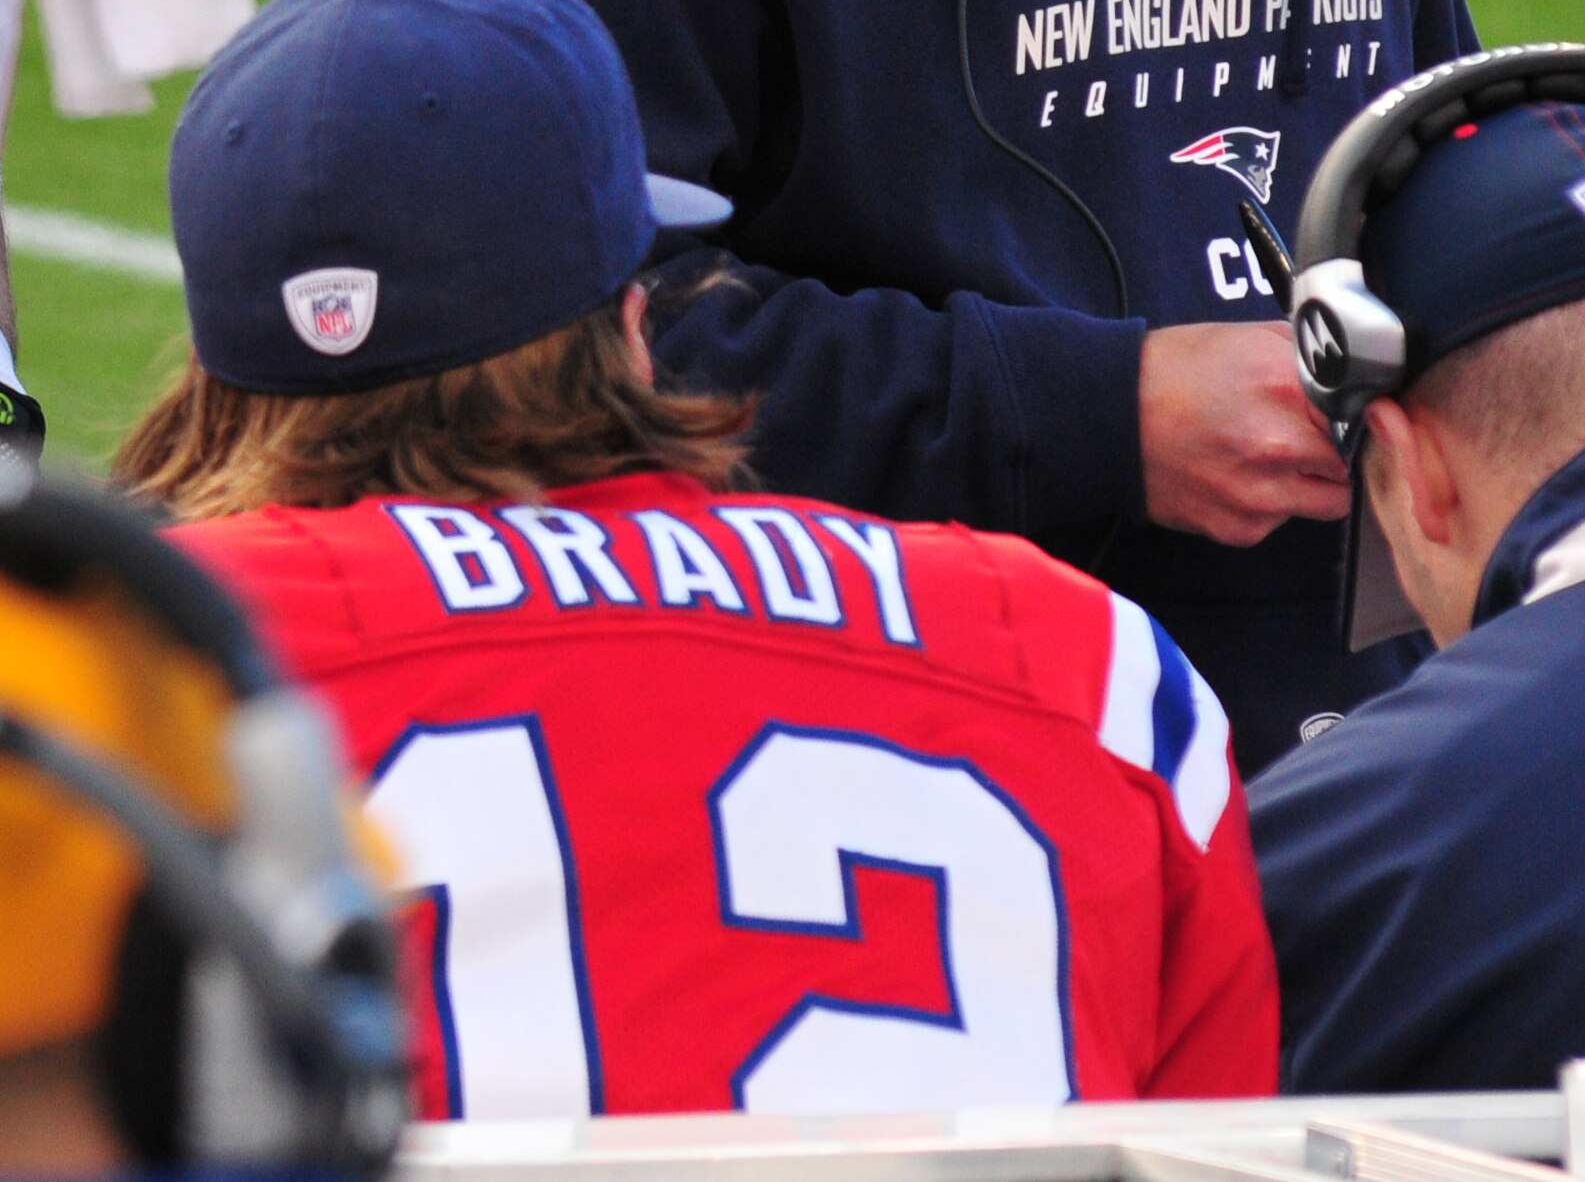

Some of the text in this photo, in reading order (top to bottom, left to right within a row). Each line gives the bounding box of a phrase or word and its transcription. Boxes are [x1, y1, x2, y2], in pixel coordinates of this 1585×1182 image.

[1039, 40, 1381, 129] EQUIPMNT
[318, 311, 354, 336] NFL
[381, 502, 923, 650] BRADY
[364, 712, 1081, 1118] 12
